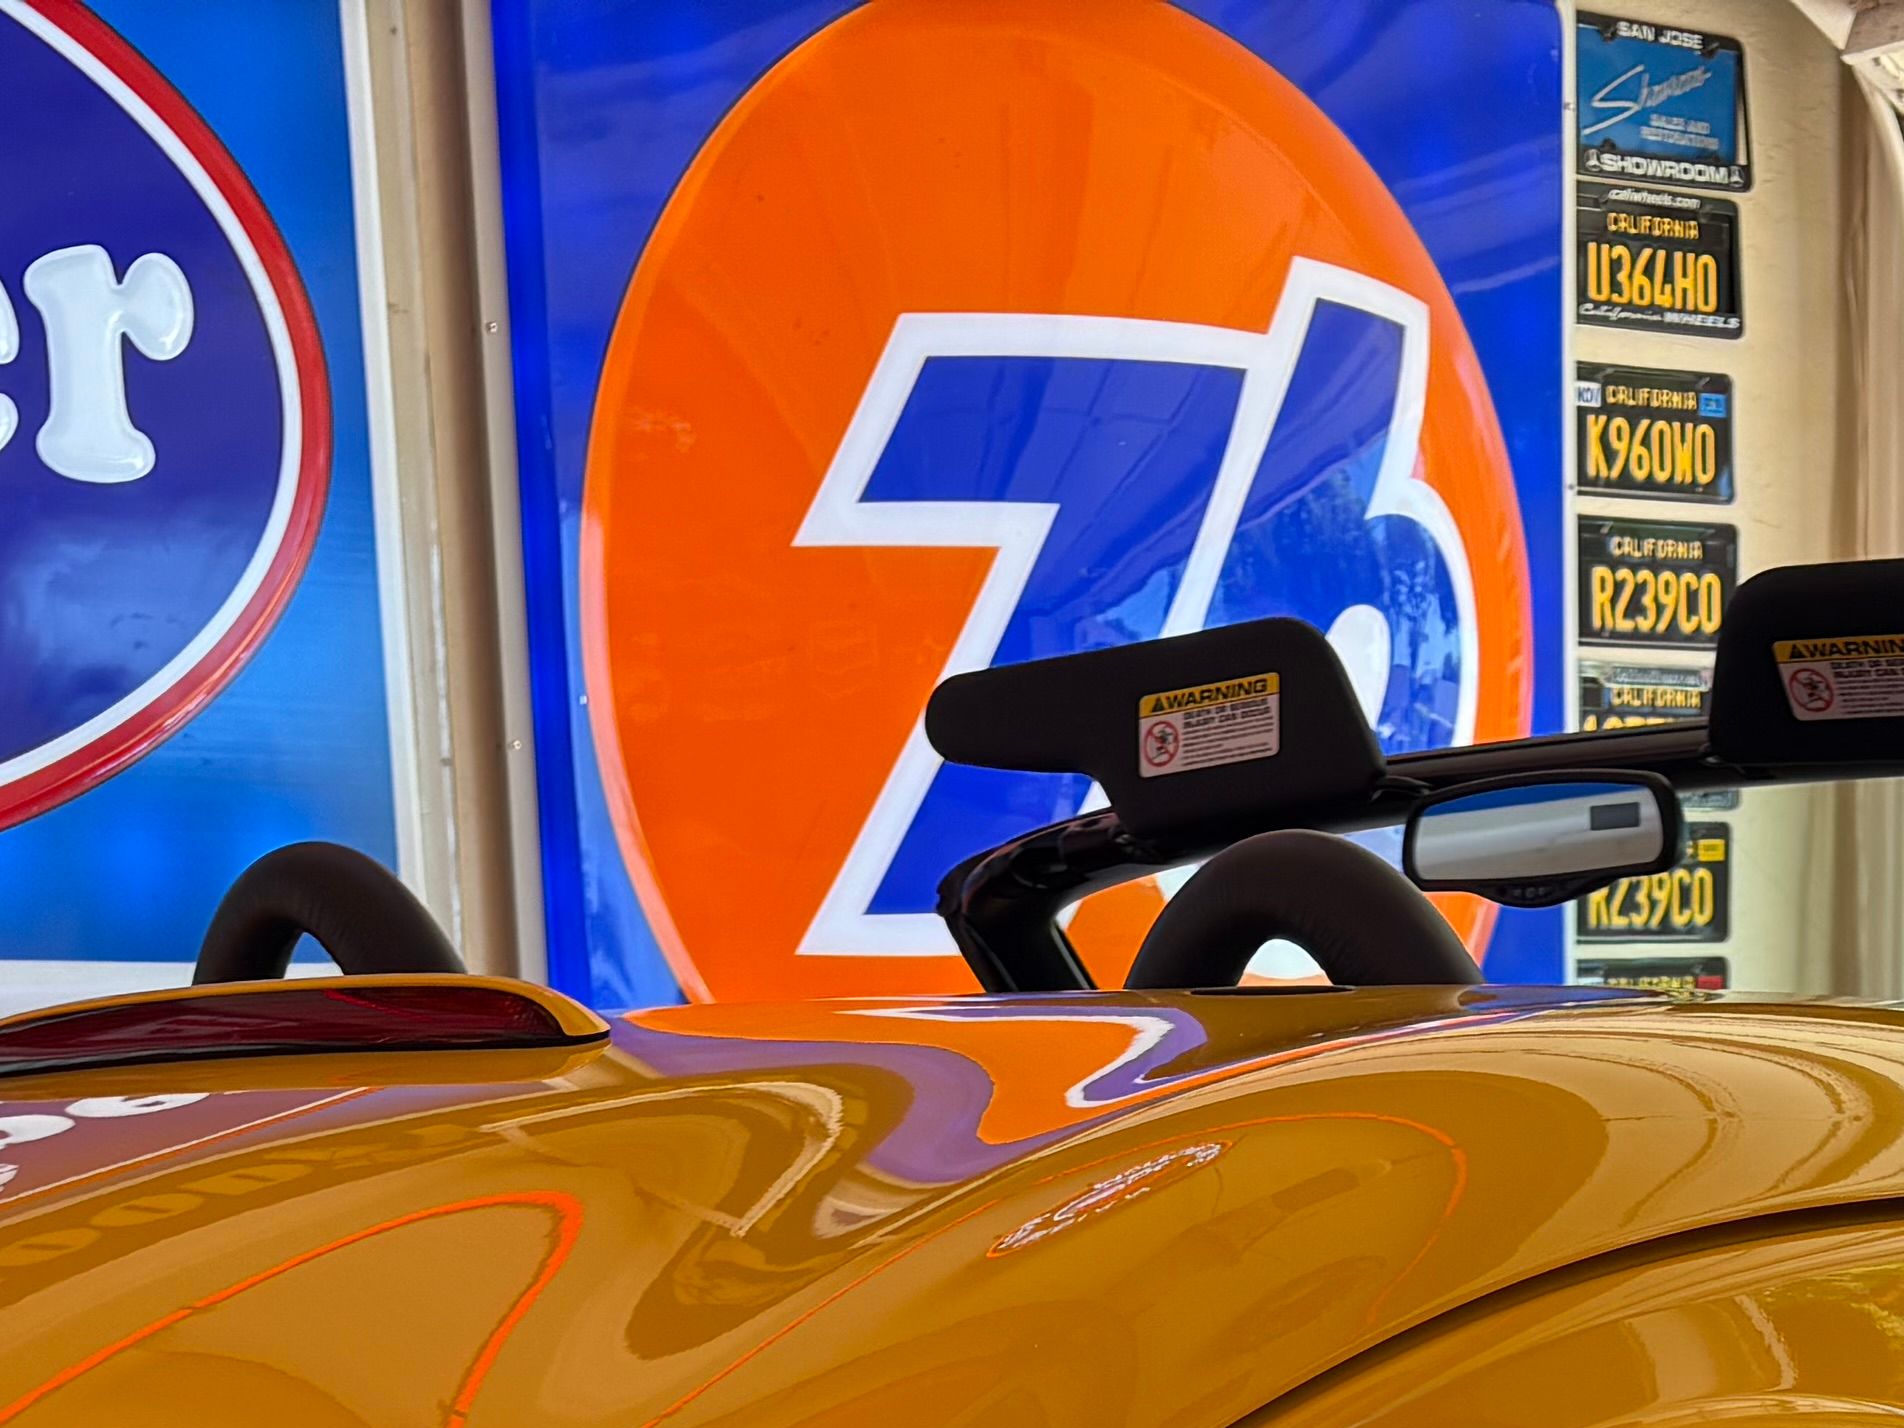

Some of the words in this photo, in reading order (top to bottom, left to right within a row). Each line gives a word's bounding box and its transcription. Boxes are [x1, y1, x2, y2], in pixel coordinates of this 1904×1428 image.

[1616, 21, 1655, 42] SAN
[1659, 30, 1704, 50] JOSE
[1600, 153, 1729, 184] SHOWROOM
[1607, 212, 1700, 239] CALIFORNIA
[1605, 385, 1697, 410] CALIFORNIA
[1611, 536, 1704, 559] CALIFORNIA
[1165, 678, 1268, 710] WARNING
[1610, 687, 1702, 708] CALIFORNIA
